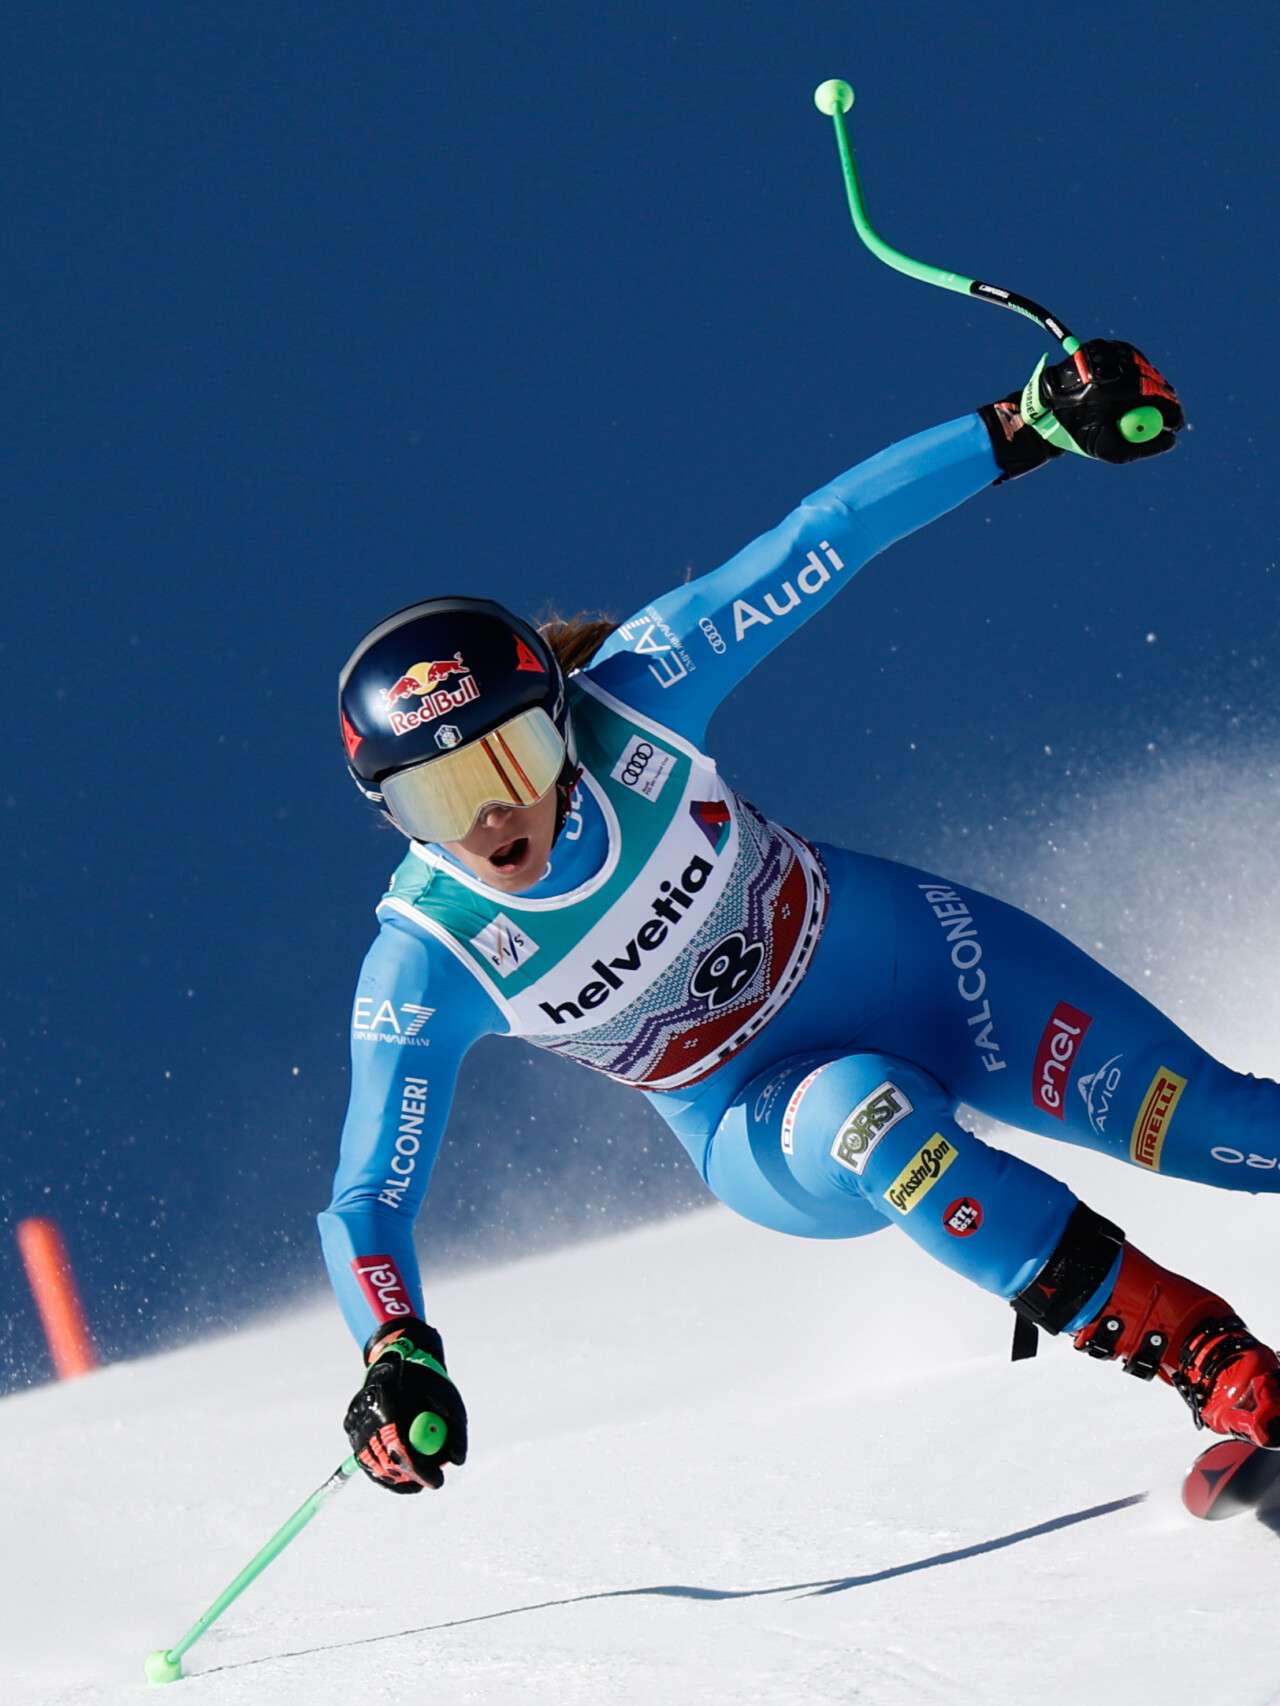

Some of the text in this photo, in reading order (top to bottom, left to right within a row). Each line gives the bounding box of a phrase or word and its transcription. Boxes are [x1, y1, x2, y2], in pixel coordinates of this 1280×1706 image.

[733, 541, 844, 641] Audi
[617, 616, 688, 689] EA7
[389, 675, 480, 735] Red Bull
[538, 855, 714, 1024] helvetia
[690, 931, 766, 1011] 8
[918, 884, 1006, 1072] FALCONERI
[354, 998, 436, 1036] EA7
[1041, 1018, 1081, 1108] enel
[1096, 1067, 1121, 1132] AVIO
[377, 1077, 428, 1208] FALCONERI
[837, 1087, 903, 1168] FORST
[1136, 1077, 1177, 1166] PIRELLI
[948, 1204, 973, 1230] RTL
[957, 1209, 978, 1232] 102.5
[357, 1263, 410, 1315] enel
